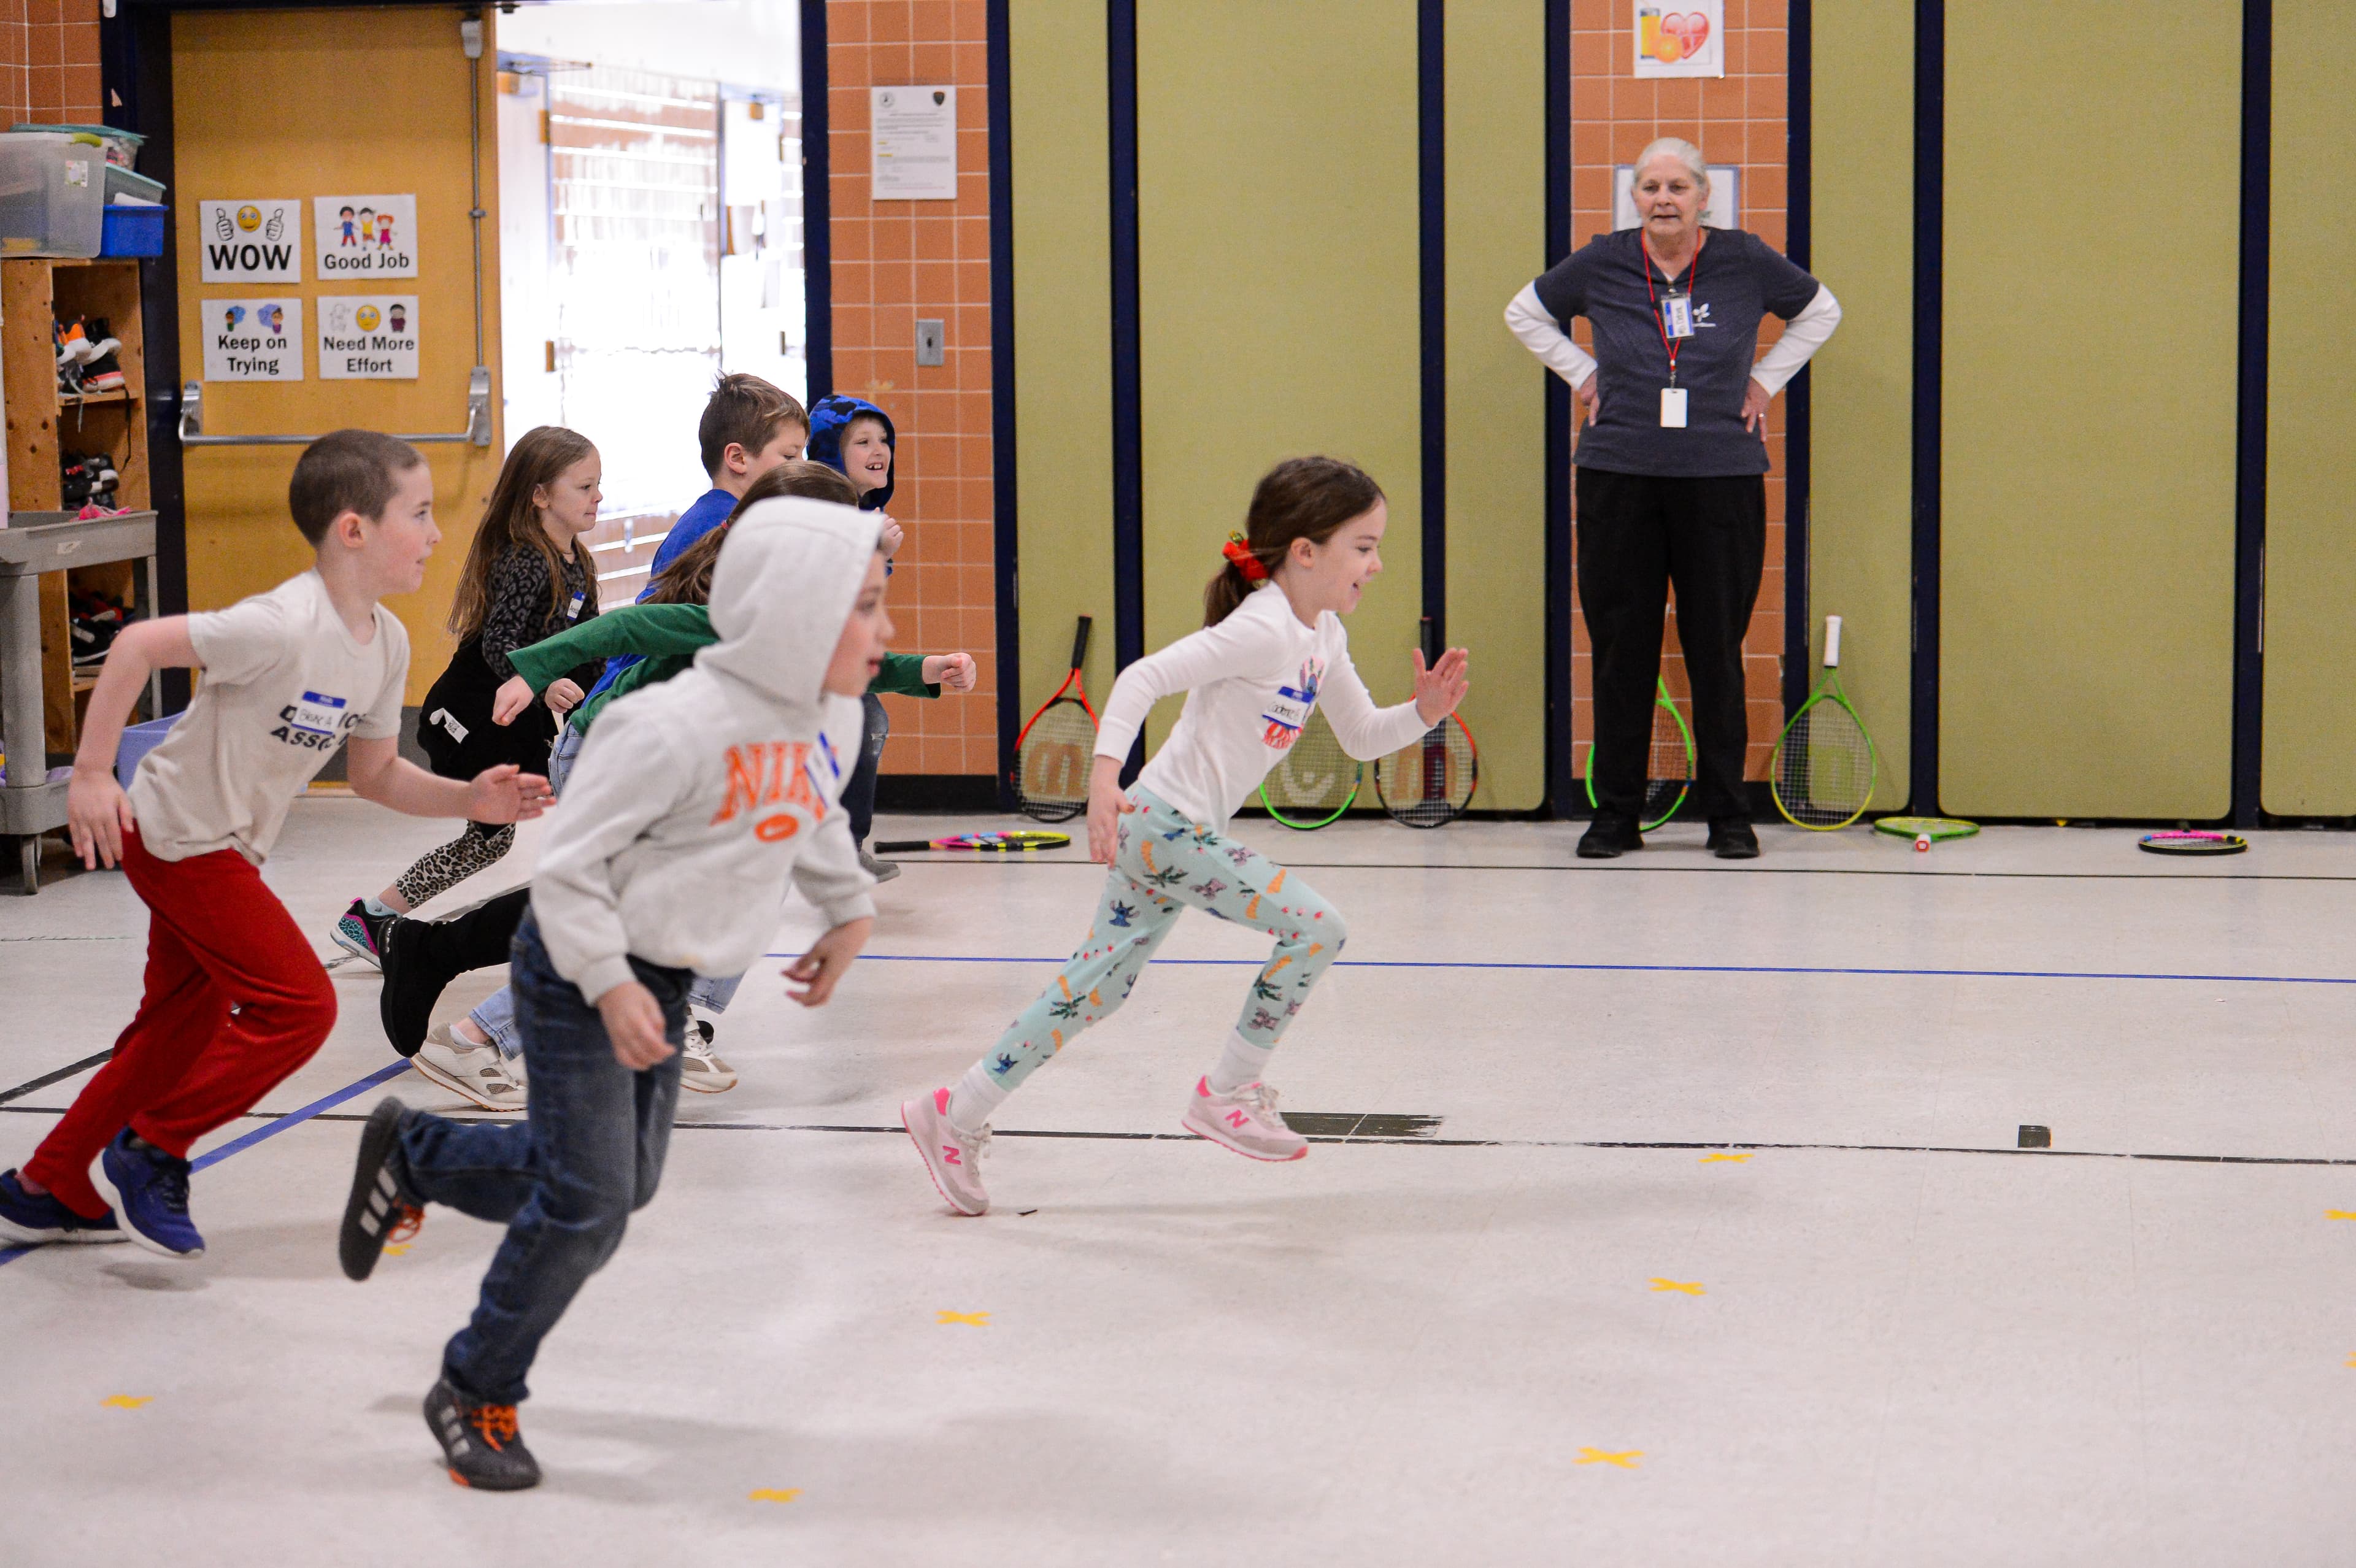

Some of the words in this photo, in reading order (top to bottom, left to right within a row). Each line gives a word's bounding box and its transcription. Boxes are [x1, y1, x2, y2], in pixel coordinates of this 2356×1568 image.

[208, 244, 293, 271] WOW
[324, 253, 371, 270] Good
[378, 252, 410, 269] Job
[218, 334, 261, 353] Keep
[266, 337, 287, 350] on
[323, 336, 366, 352] Need
[372, 336, 415, 351] More
[227, 356, 279, 375] Trying
[347, 358, 393, 374] Effort
[710, 740, 839, 827] NIK
